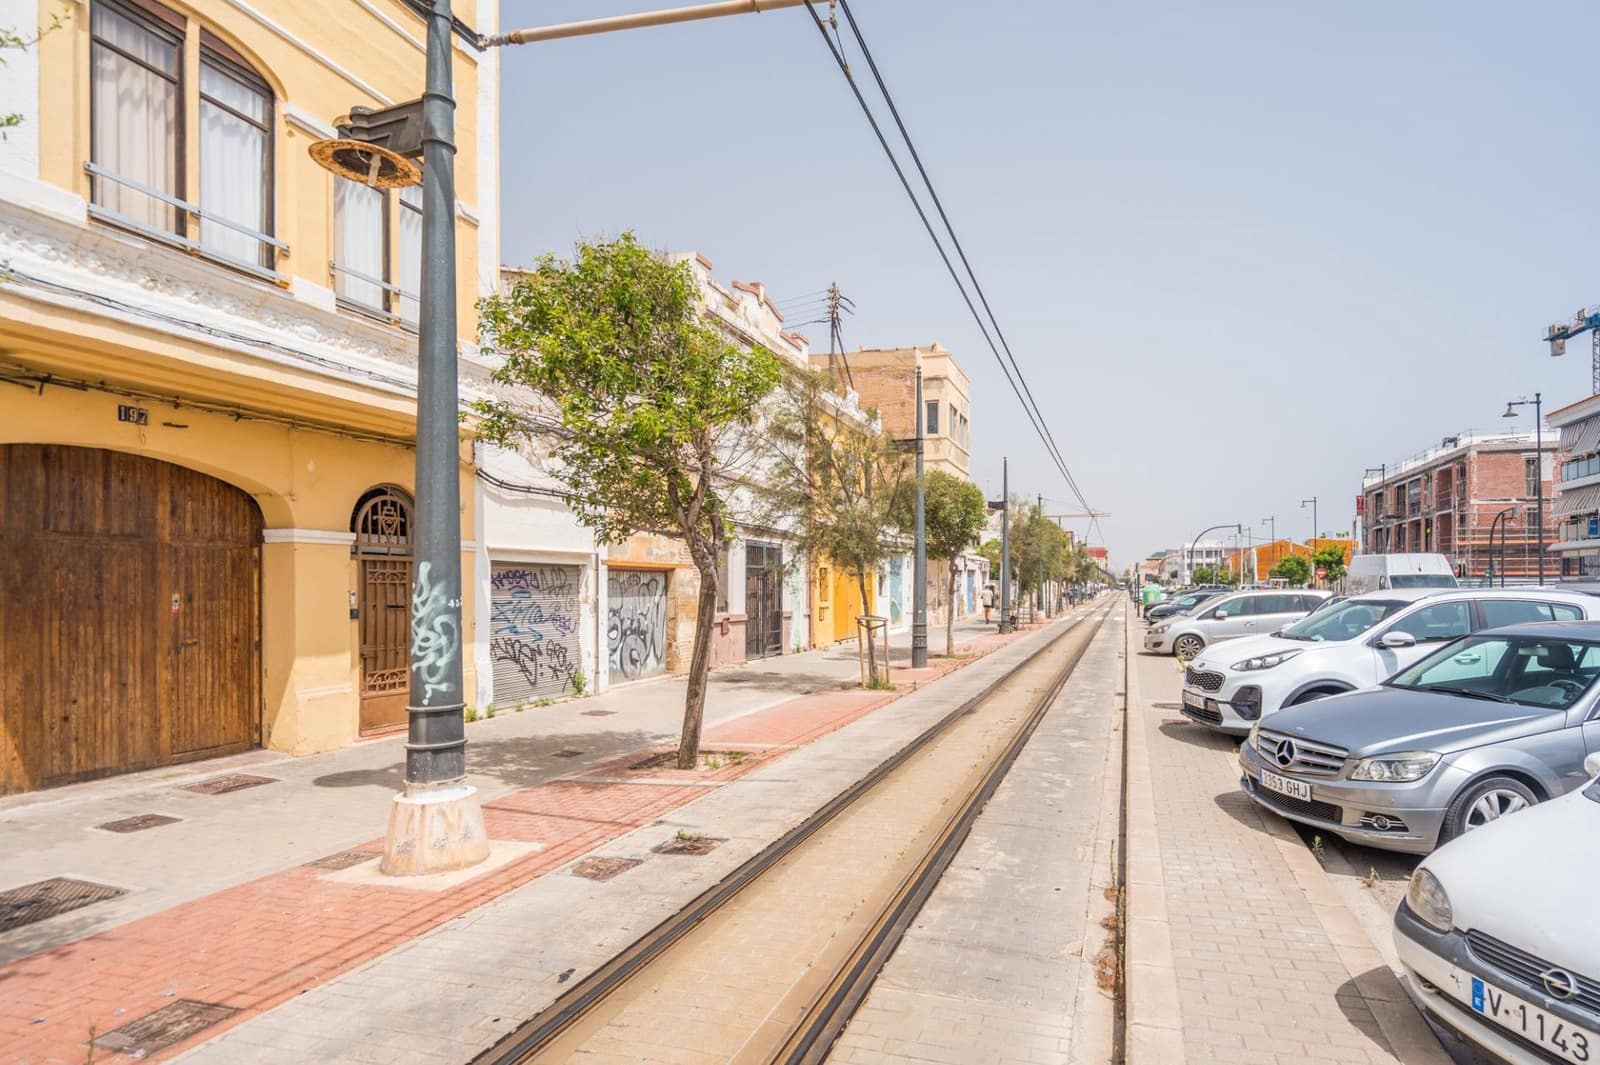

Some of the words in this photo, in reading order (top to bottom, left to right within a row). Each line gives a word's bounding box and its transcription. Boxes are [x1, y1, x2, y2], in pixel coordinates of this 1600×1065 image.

[119, 406, 147, 424] 197
[1264, 772, 1283, 791] 3353
[1286, 780, 1308, 798] GHJ
